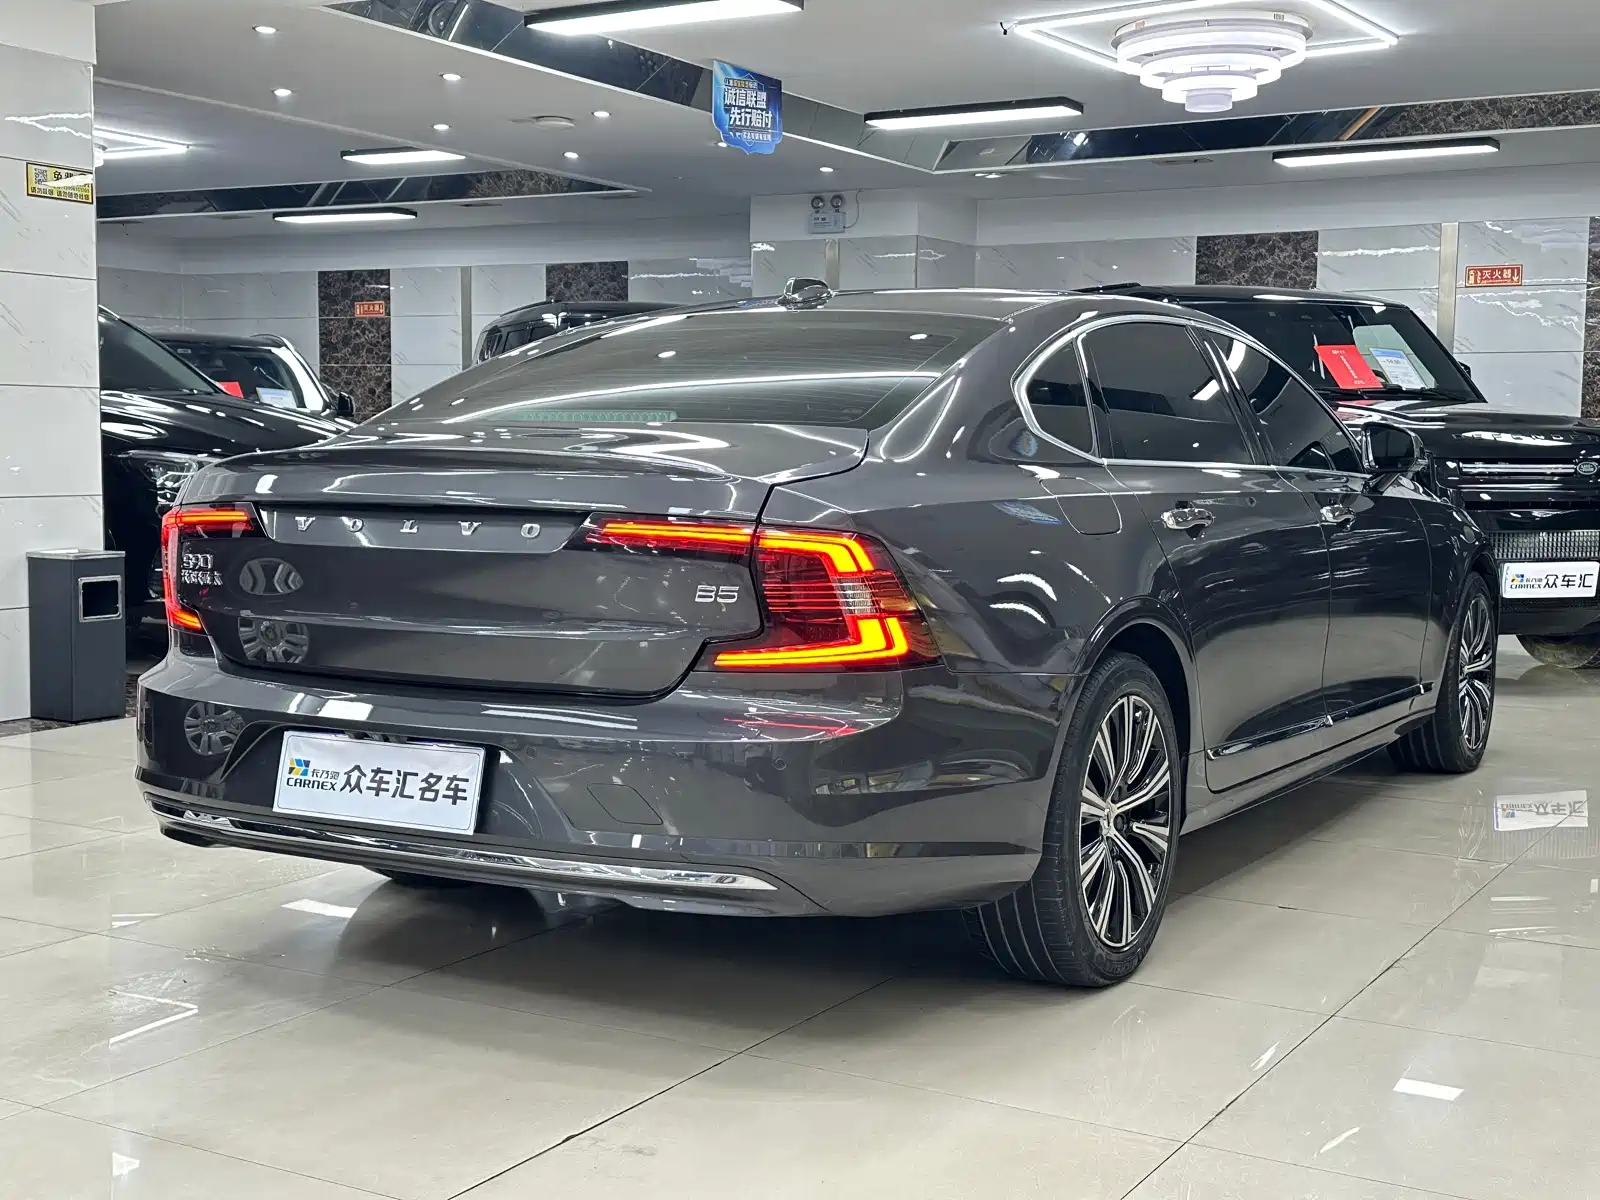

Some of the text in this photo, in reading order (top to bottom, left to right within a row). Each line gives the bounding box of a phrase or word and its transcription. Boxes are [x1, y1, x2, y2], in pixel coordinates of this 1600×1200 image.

[724, 86, 767, 109] 诚信联盟
[729, 107, 773, 129] 先行赔付
[1482, 269, 1512, 280] 灭火器
[294, 516, 541, 539] VOLVO
[1543, 573, 1594, 589] 众车汇
[695, 584, 740, 603] B5
[286, 776, 338, 793] CARNEX
[339, 764, 470, 806] 众车汇名车
